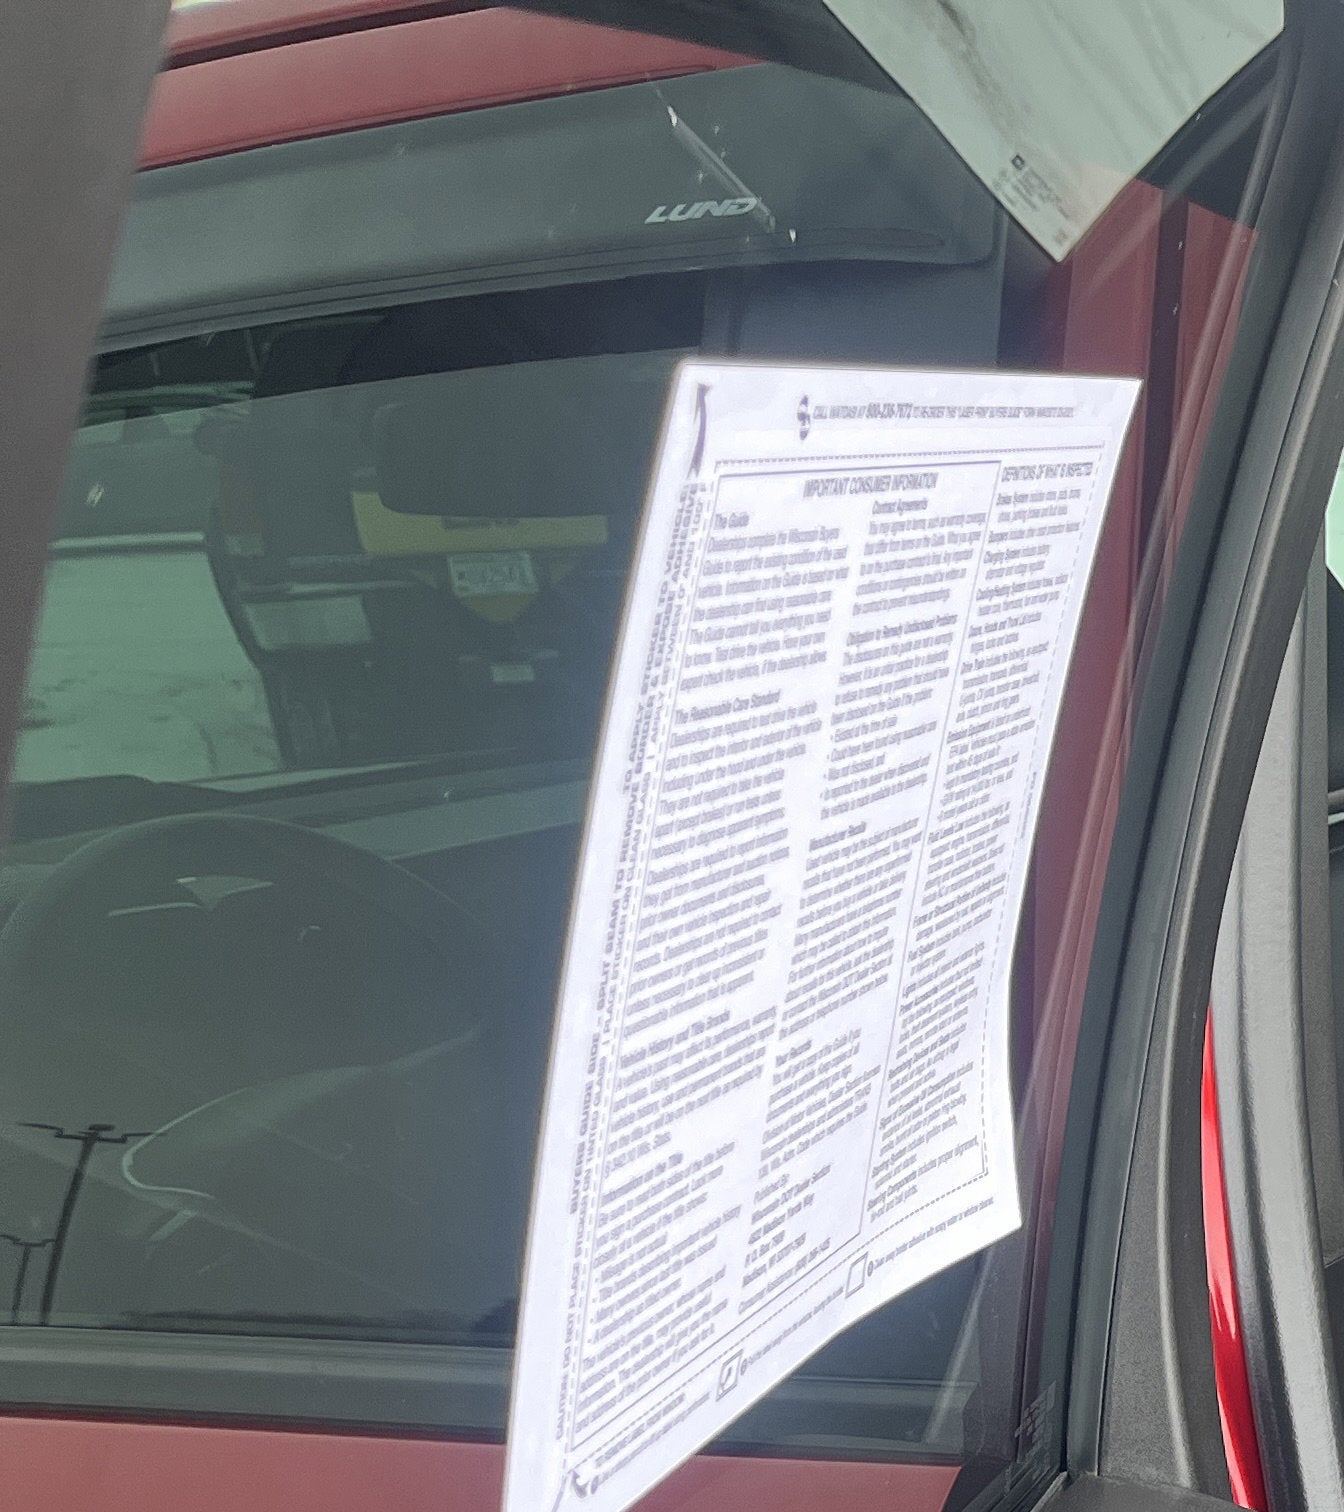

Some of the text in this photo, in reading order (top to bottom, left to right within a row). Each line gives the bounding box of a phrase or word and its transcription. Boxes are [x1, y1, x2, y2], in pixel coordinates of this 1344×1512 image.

[644, 197, 757, 224] LUND
[803, 472, 938, 498] IMPORTANT CONSUMER INFORMATION
[1001, 462, 1094, 482] DEFINITIONS OF WHAT IS INSPECTED
[714, 512, 750, 530] The Guide
[674, 688, 781, 726] The Reasonable Care Standard
[620, 1009, 730, 1070] Vehicle History and Title Brands
[600, 1152, 683, 1208] Information on the Title
